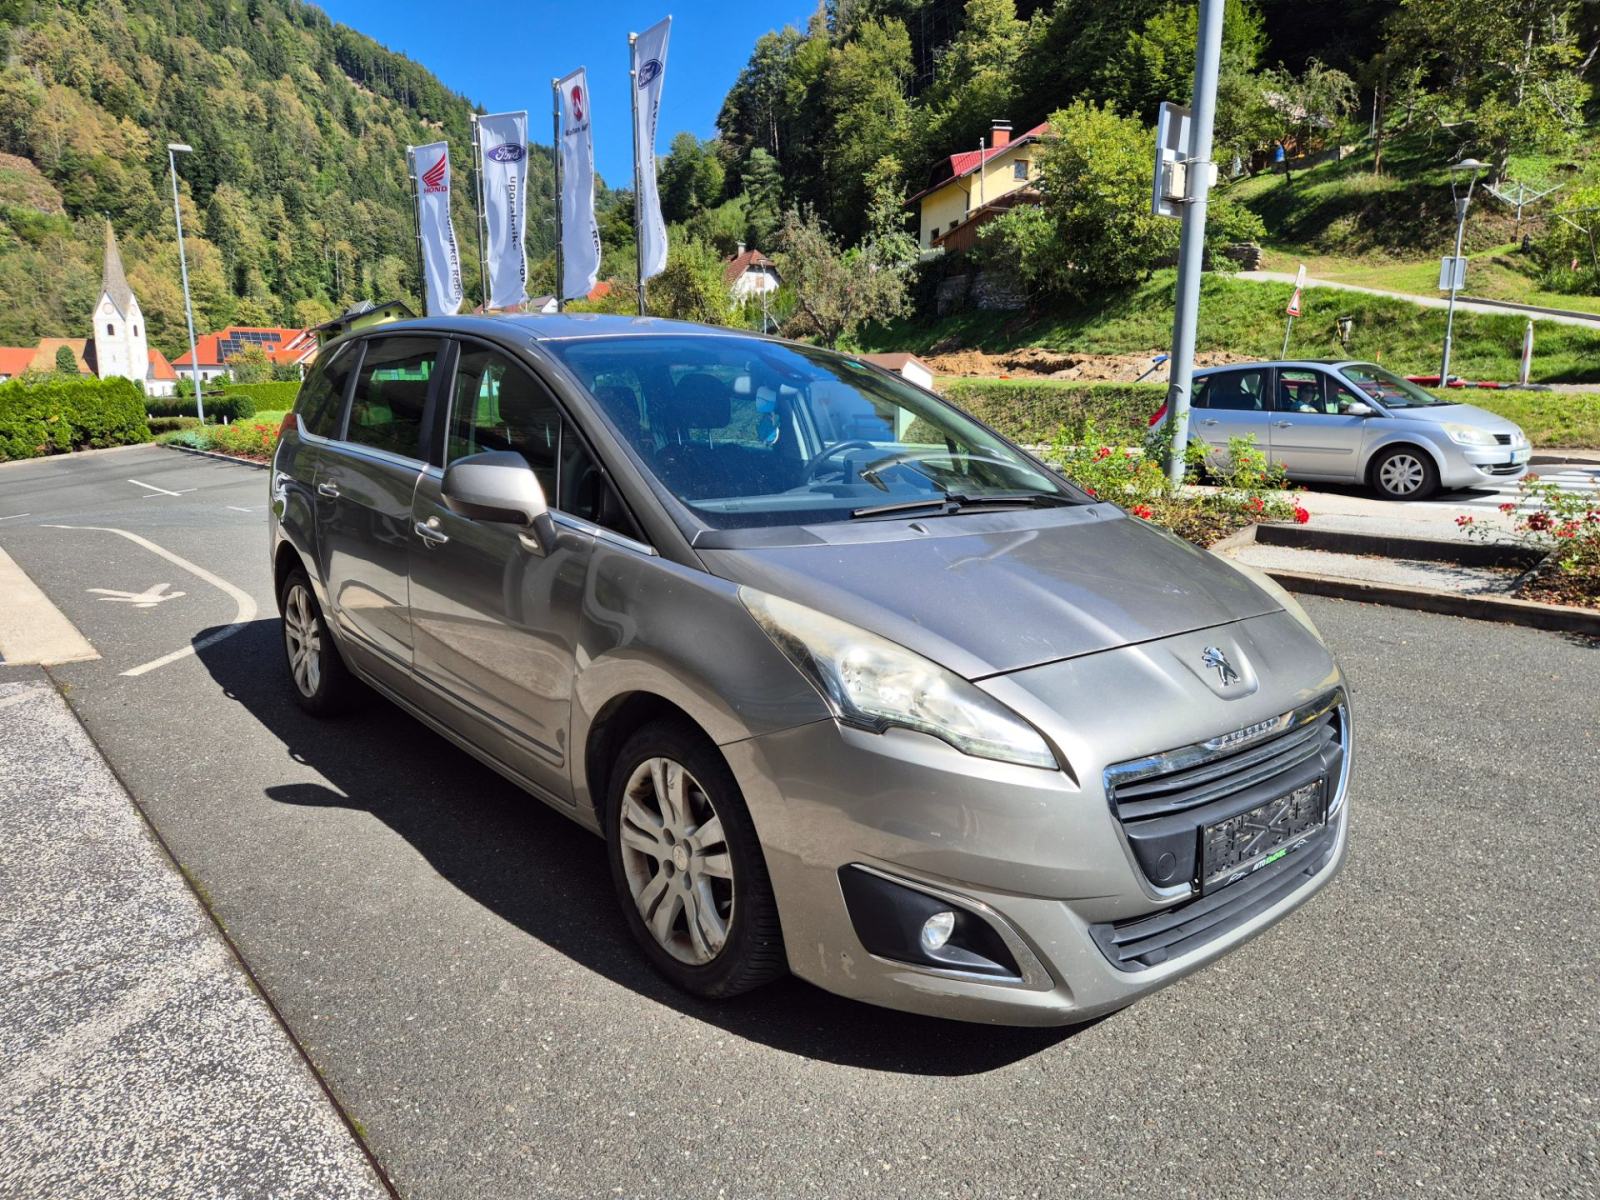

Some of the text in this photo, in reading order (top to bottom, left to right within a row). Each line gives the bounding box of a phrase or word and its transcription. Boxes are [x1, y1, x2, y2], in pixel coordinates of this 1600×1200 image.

[495, 146, 520, 160] Ford
[423, 185, 448, 194] HOND
[1221, 718, 1275, 744] PEUGEOT
